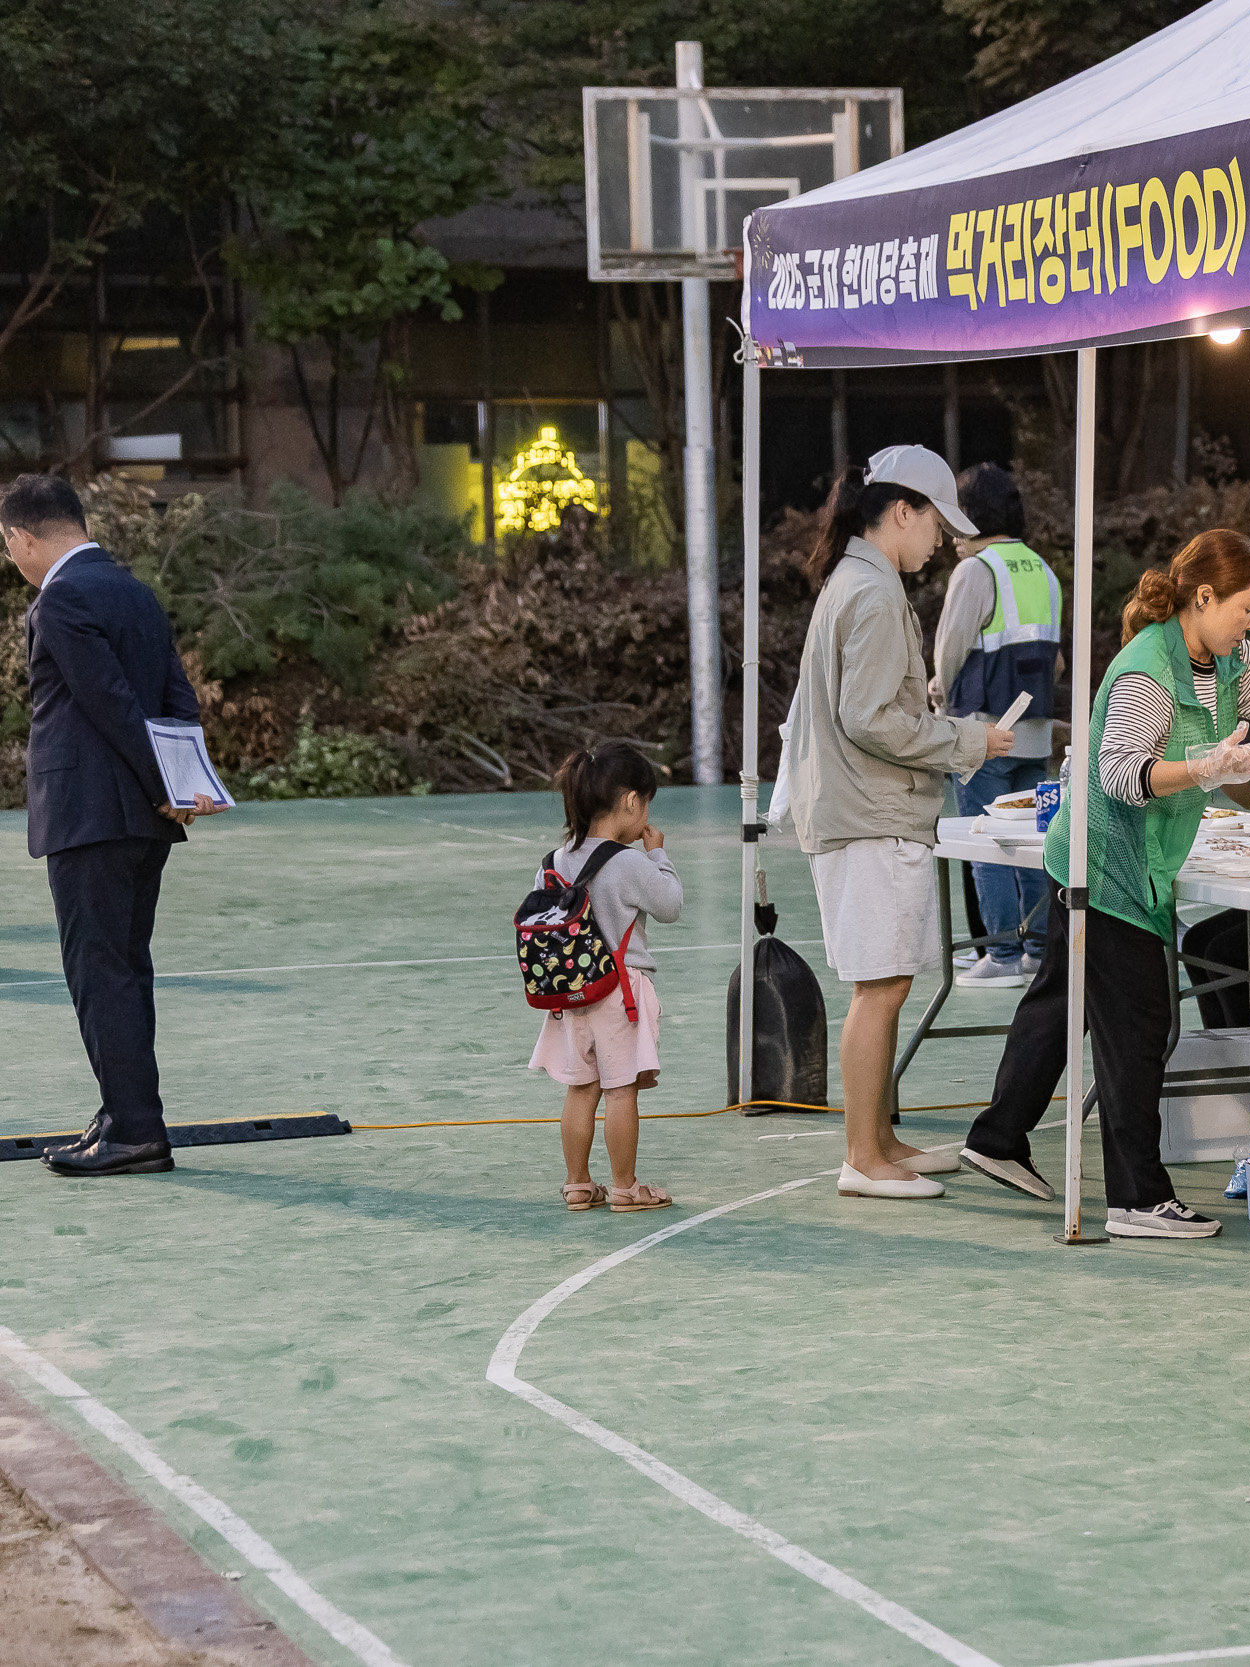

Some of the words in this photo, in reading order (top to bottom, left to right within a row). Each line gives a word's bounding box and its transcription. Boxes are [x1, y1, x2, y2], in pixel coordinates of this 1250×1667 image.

[767, 252, 806, 311] 2025
[804, 247, 841, 310] 군자
[841, 233, 939, 310] 한마당축제
[946, 156, 1246, 311] 먹거리장터(FOOD)
[1004, 558, 1043, 573] 광진구
